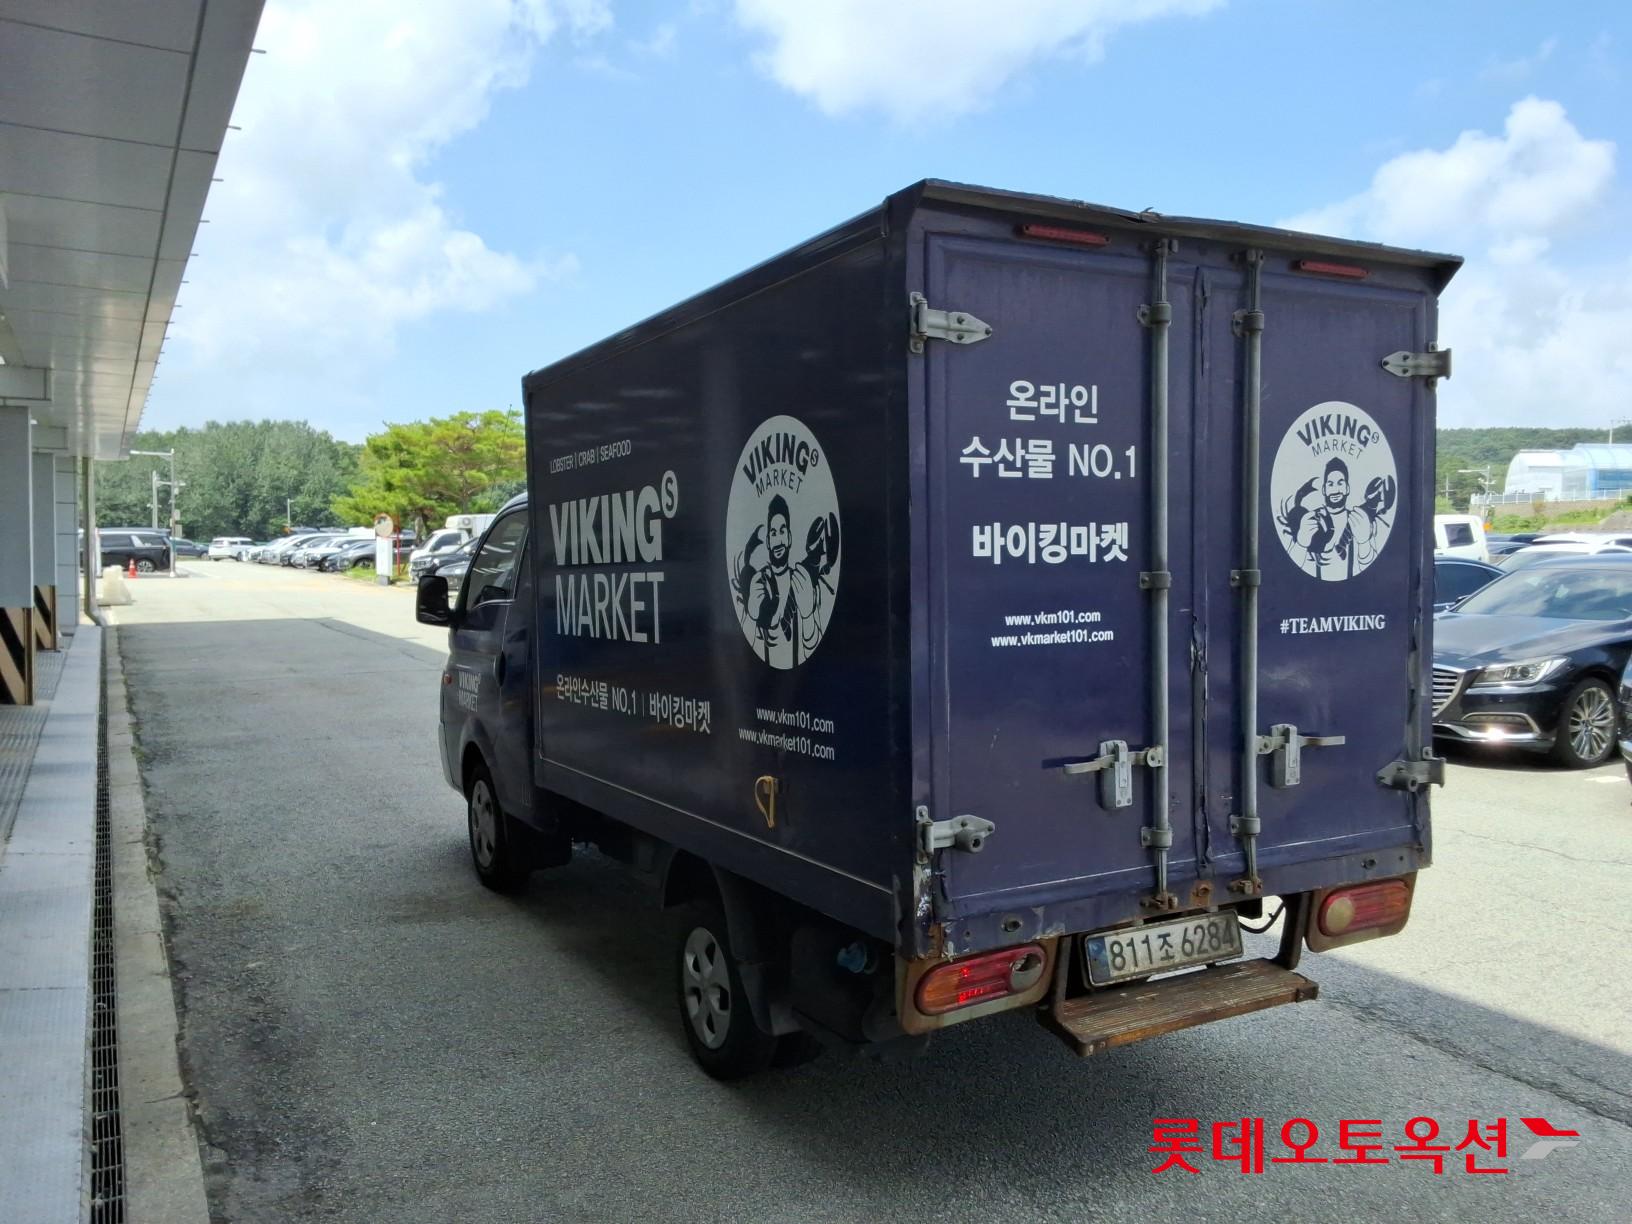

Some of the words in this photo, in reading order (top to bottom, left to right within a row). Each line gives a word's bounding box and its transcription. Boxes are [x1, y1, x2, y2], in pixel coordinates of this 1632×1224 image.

[1006, 380, 1098, 424] 온라인
[550, 455, 574, 474] LOBSTER
[578, 449, 595, 467] CRAB
[600, 439, 632, 462] SEAFOOD
[959, 436, 1056, 479] 수산물
[1068, 443, 1136, 480] NO.1
[1311, 438, 1363, 459] MARKET
[755, 467, 804, 498] MARKET
[972, 522, 1129, 565] 바이킹마켓
[555, 571, 665, 645] MARKET
[1004, 610, 1101, 626] www.vkm101.com
[1280, 614, 1386, 634] #TEAMVIKING
[990, 629, 1114, 647] www.vkmarket101.com
[611, 686, 636, 716] NO.1
[649, 691, 711, 735] 바이킹마켓
[756, 707, 835, 734] www.vkm101.com
[738, 727, 835, 761] www.vkmarket101.com
[1110, 931, 1175, 972] 811조
[1181, 918, 1236, 958] 6284
